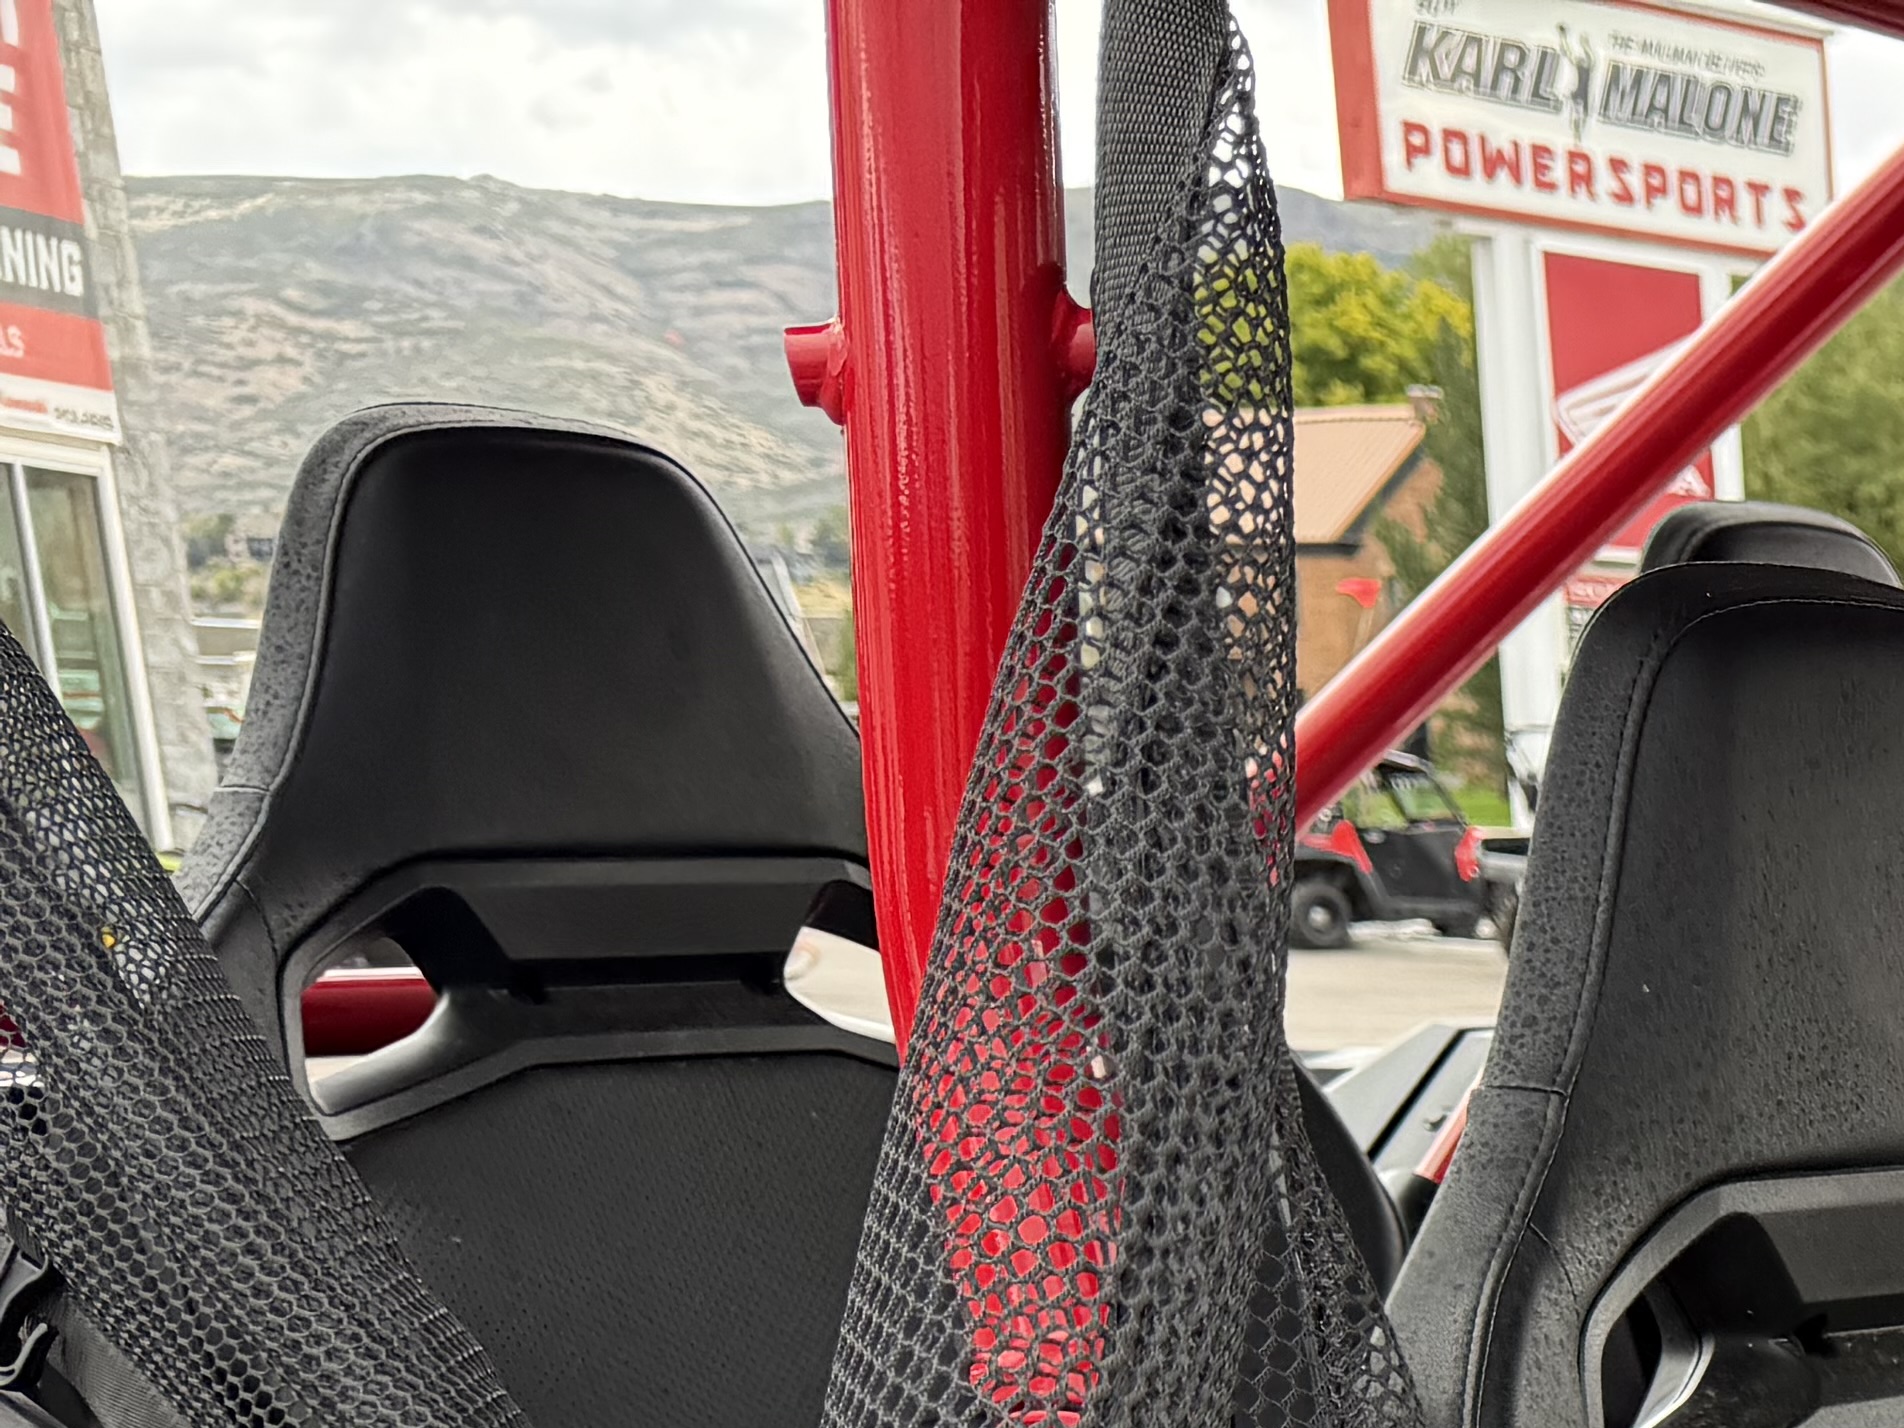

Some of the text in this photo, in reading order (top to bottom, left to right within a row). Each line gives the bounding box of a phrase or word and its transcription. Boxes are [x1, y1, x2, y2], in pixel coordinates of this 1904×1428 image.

[1402, 20, 1802, 157] KARL MALONE
[1402, 120, 1808, 232] POWERSPORTS
[0, 225, 84, 297] NING
